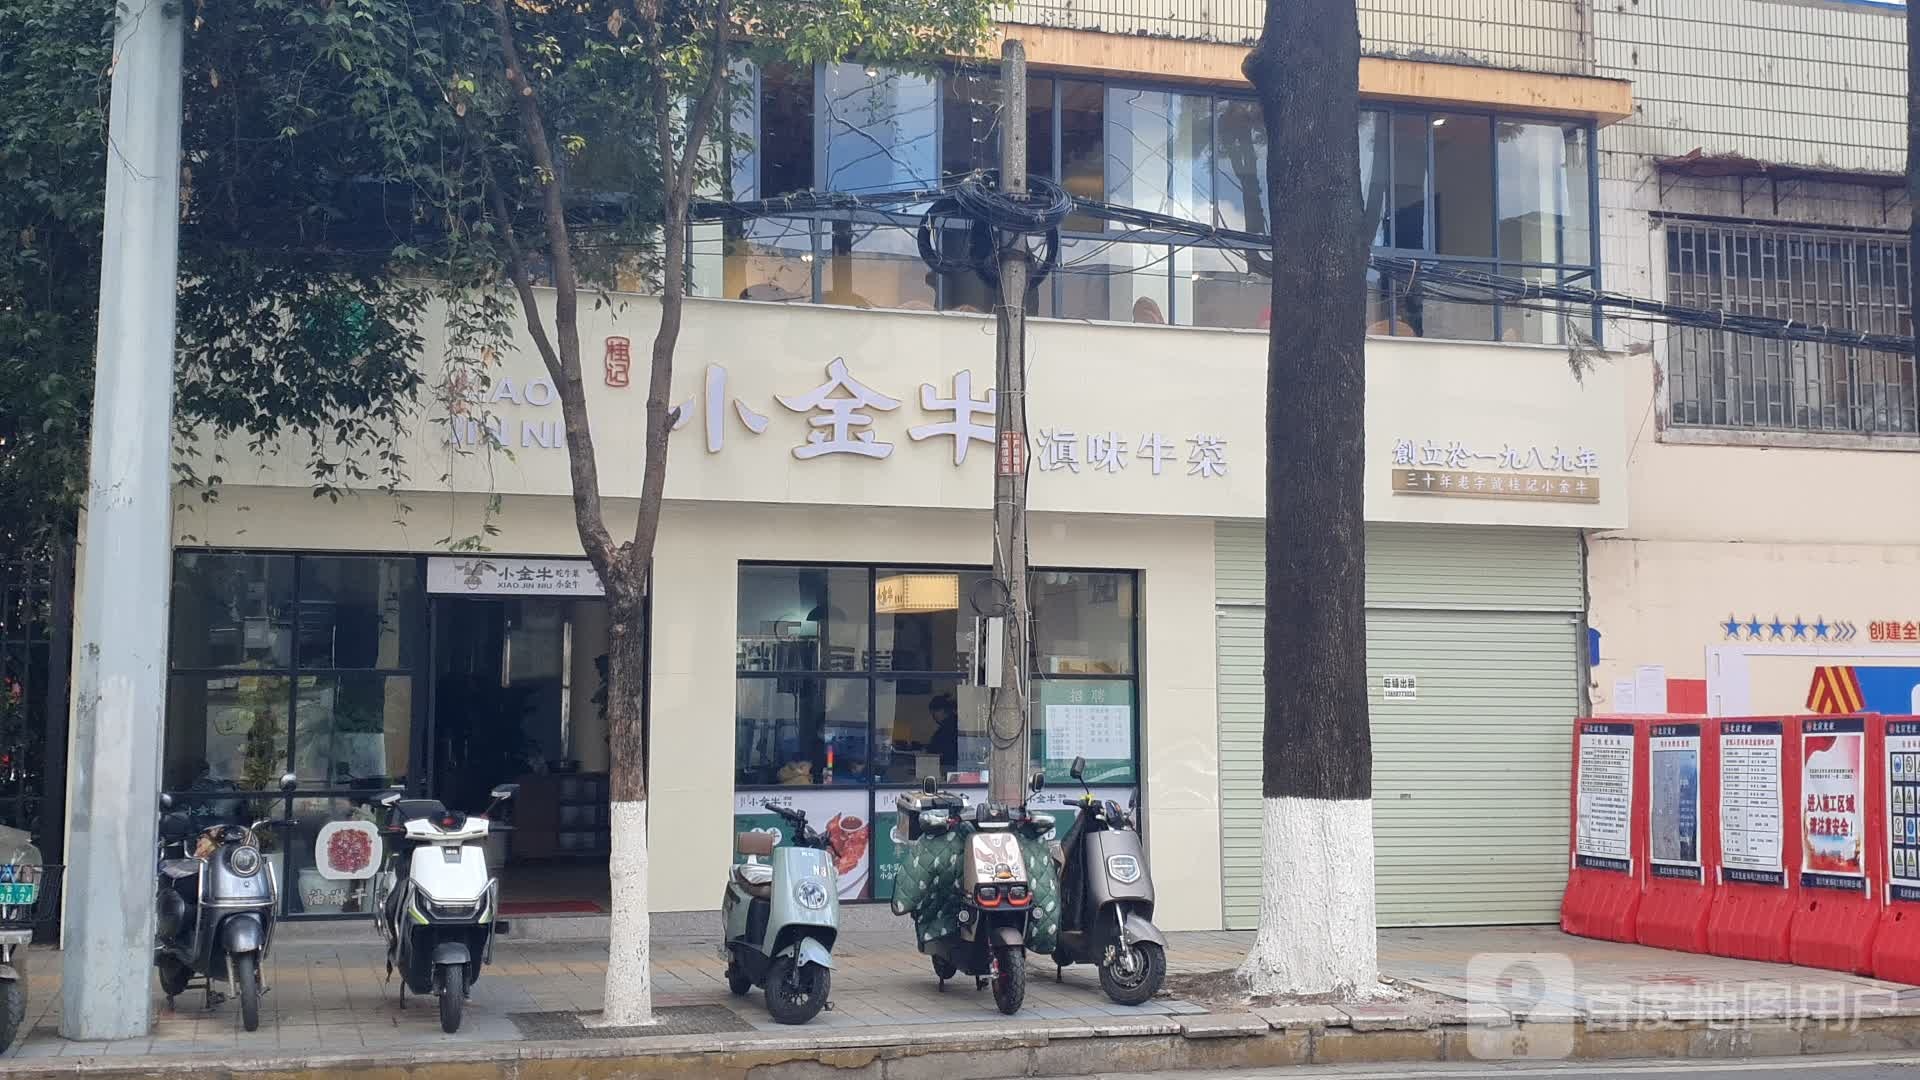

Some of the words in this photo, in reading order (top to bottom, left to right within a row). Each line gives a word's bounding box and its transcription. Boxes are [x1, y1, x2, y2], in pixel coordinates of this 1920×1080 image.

[607, 339, 629, 384] 桂记
[668, 356, 997, 467] 小金牛
[1036, 425, 1229, 478] 滇味牛菜
[498, 565, 554, 581] 小金牛
[497, 581, 519, 589] XIAO
[1869, 620, 1920, 641] 创建全
[1807, 793, 1856, 814] 进入施工区域
